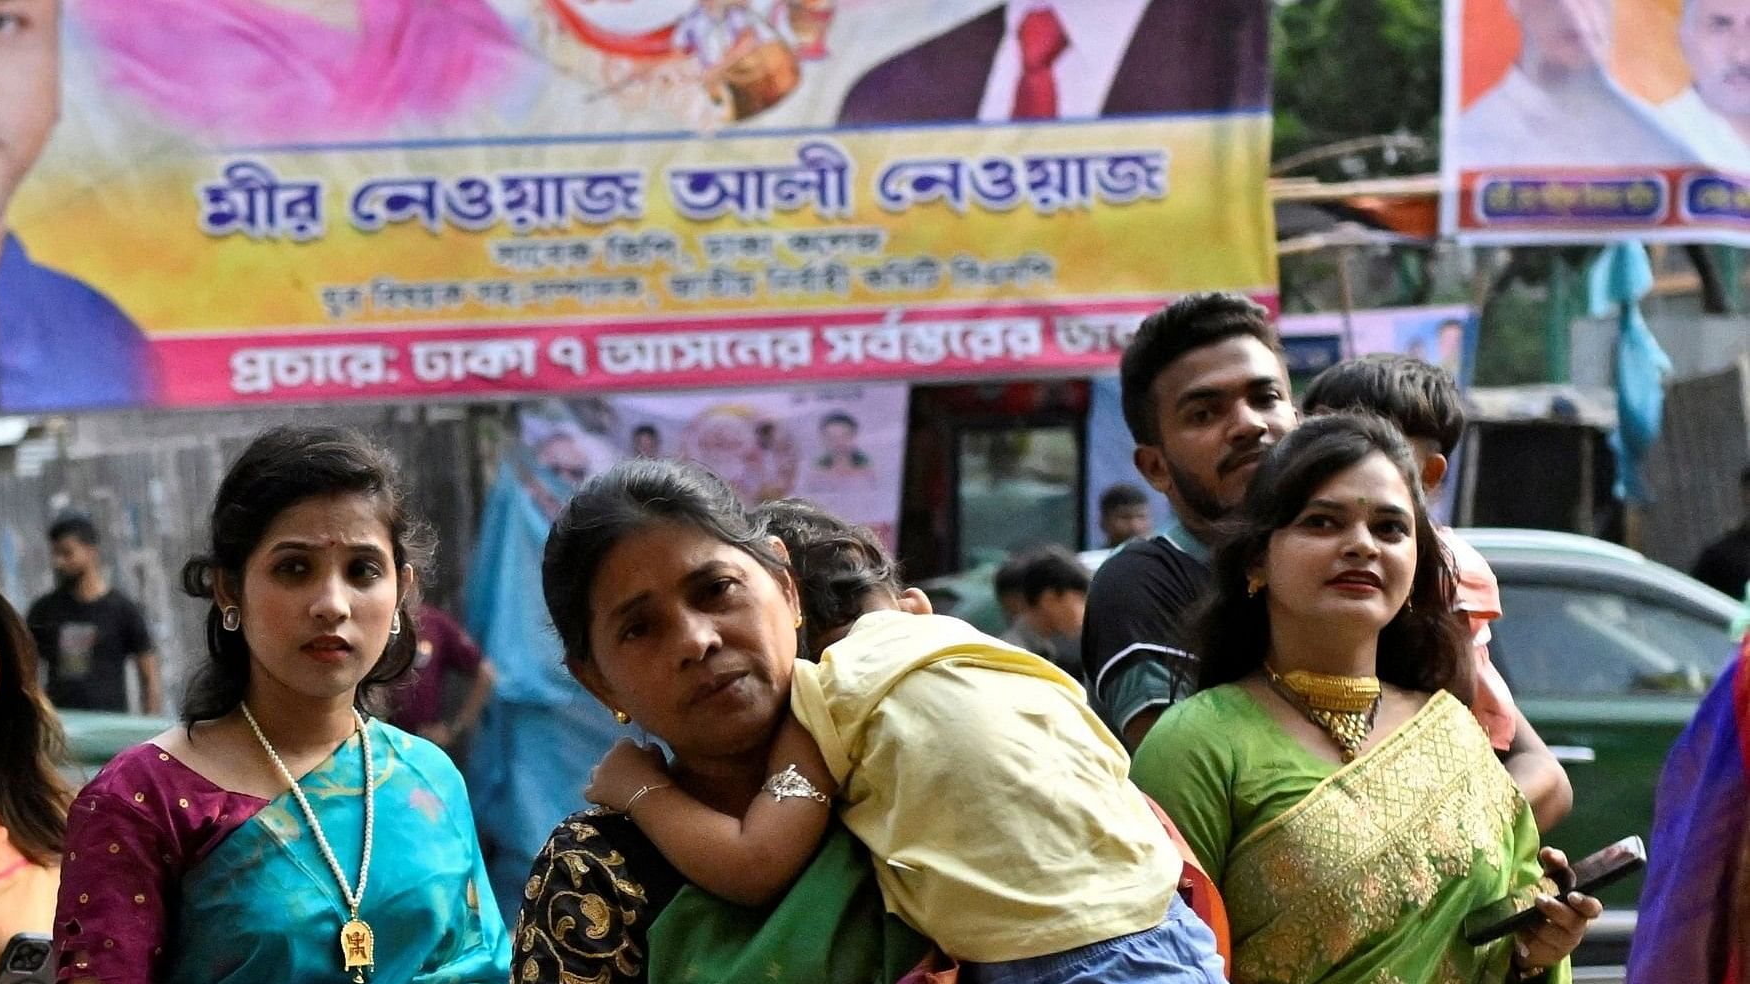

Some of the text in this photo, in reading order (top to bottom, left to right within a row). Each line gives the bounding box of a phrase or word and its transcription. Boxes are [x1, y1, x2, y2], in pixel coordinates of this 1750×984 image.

[201, 140, 1167, 237] মীর নেওয়াজ আলী নেওয়াজ
[230, 343, 400, 394] প্রচারে:
[411, 336, 538, 382] ঢাকা
[550, 336, 586, 375] ৭
[597, 323, 813, 373] আসনের
[822, 308, 1042, 365] সর্বস্তরের
